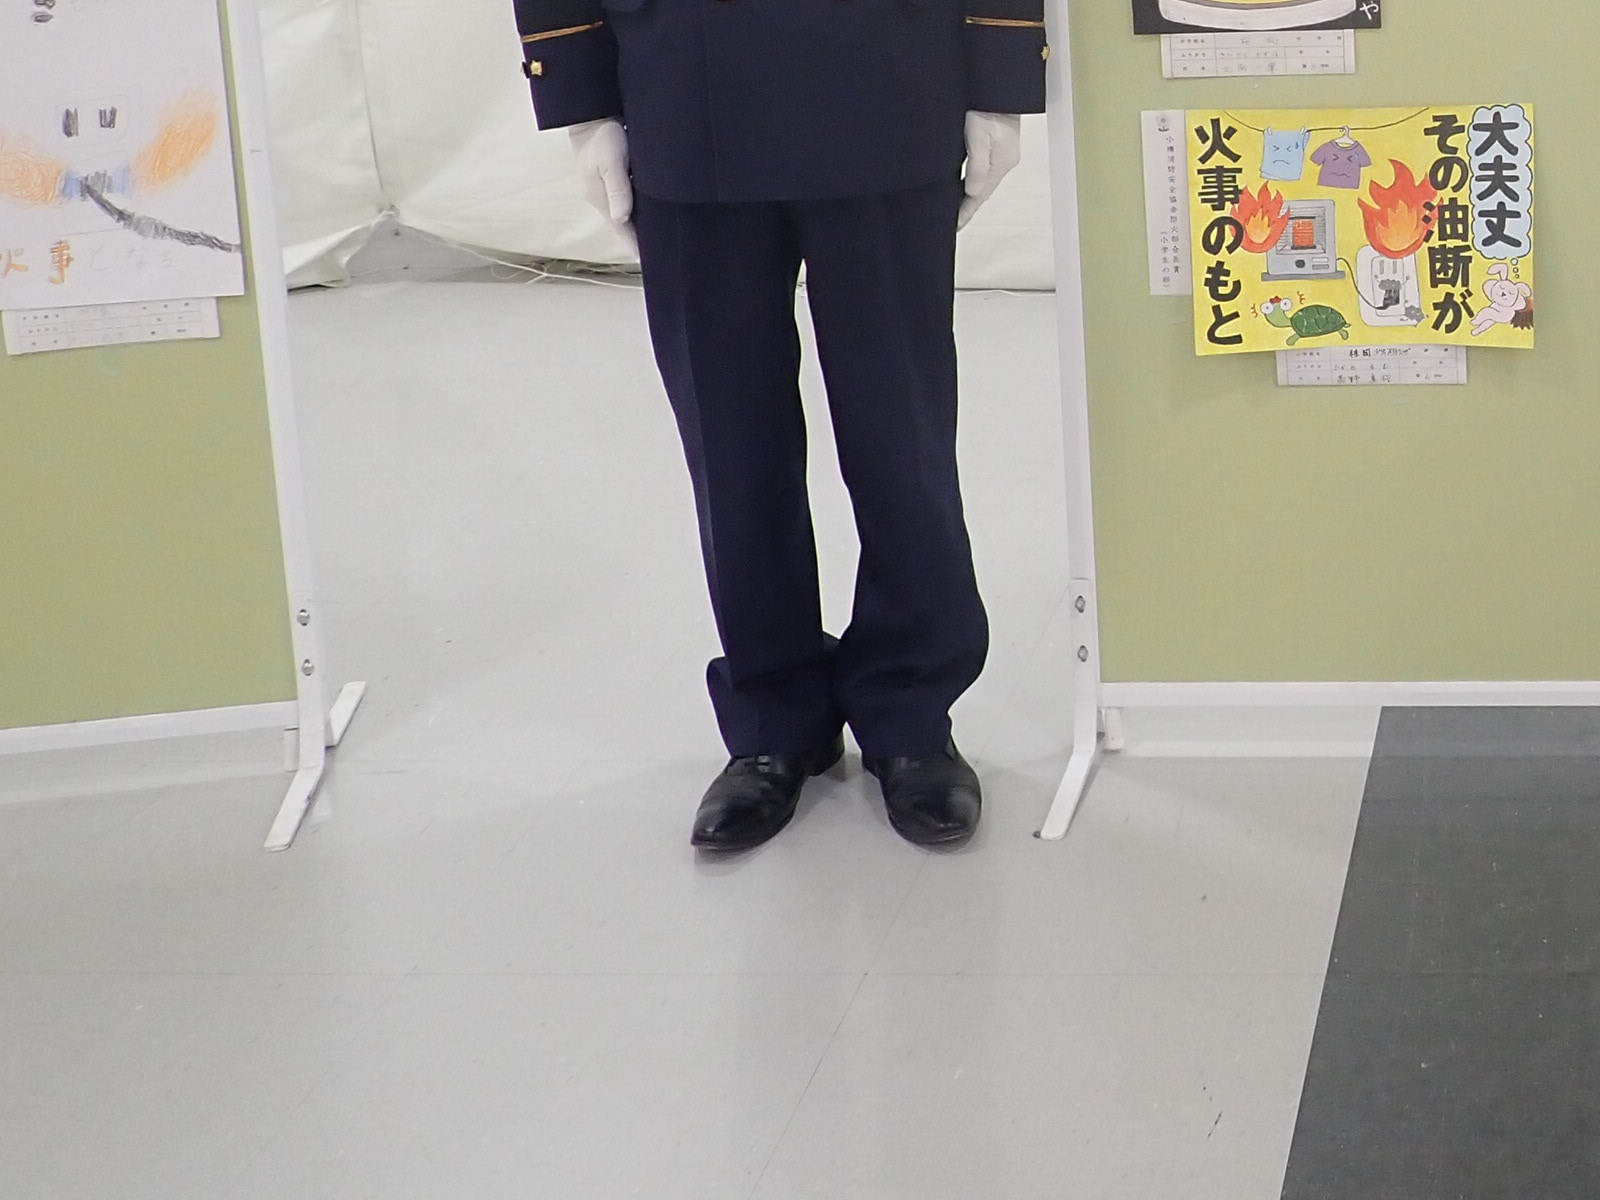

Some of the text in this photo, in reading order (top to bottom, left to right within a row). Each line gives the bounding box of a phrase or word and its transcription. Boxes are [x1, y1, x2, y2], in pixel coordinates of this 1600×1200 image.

[1194, 118, 1245, 346] 火事のもと
[1422, 114, 1475, 334] その油断が
